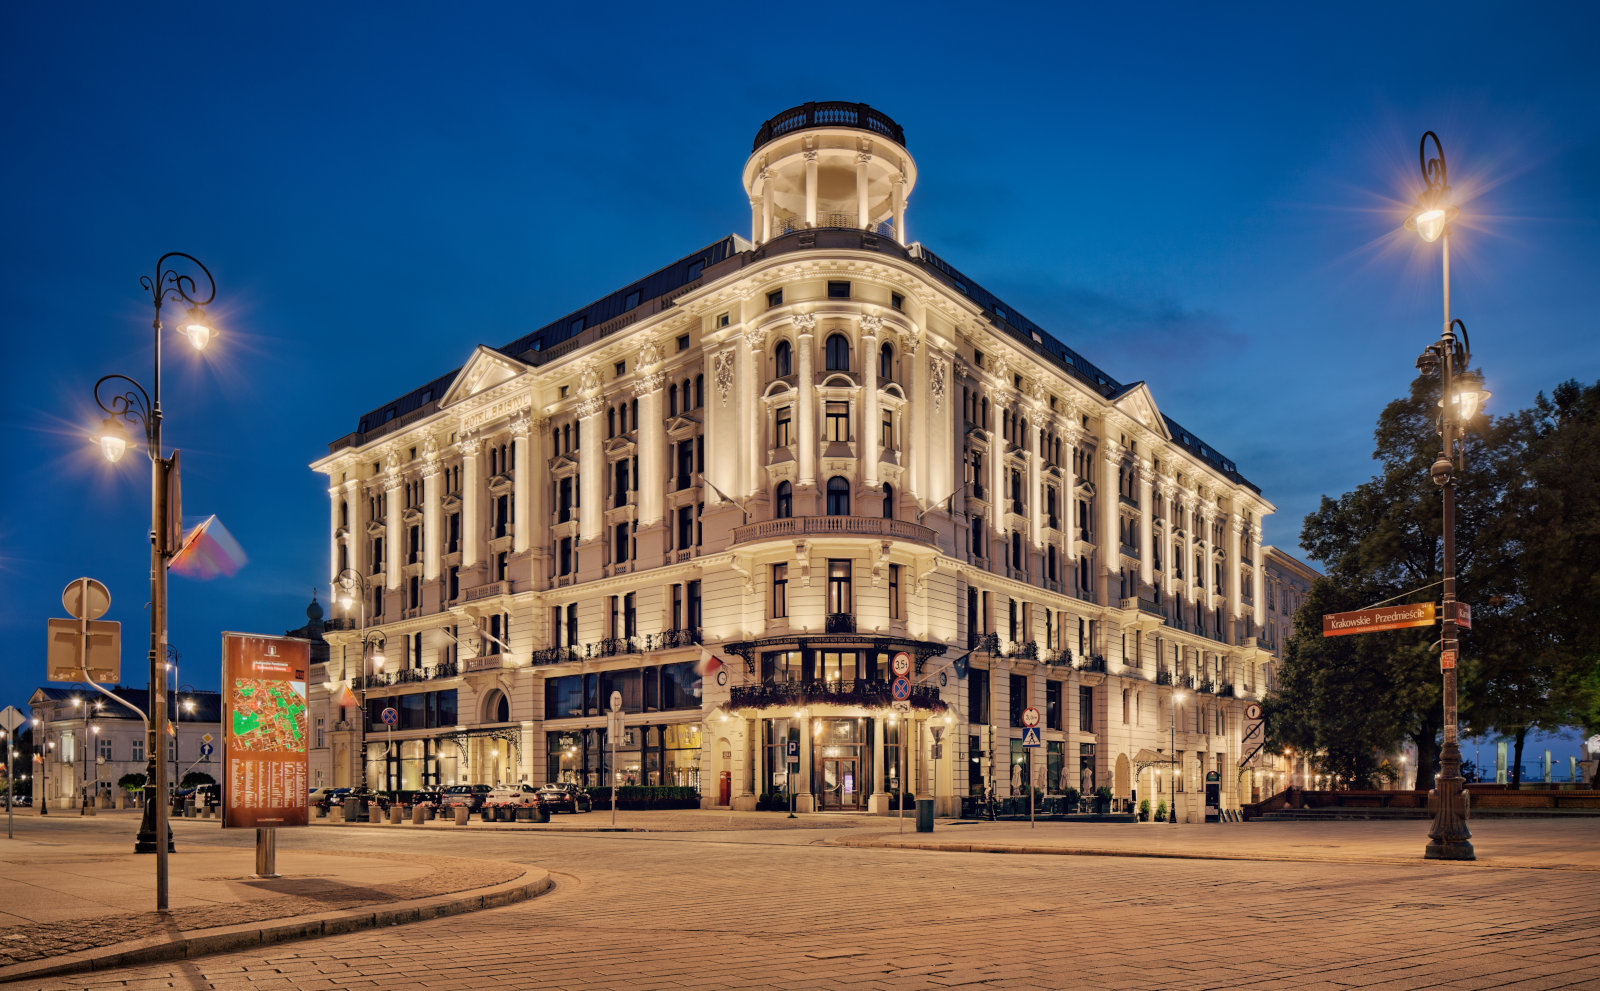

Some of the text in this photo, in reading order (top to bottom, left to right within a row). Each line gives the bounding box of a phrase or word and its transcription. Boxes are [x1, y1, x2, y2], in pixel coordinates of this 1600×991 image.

[464, 394, 529, 430] HOTEL BRISTOL
[1331, 615, 1371, 630] Krakowskie
[1375, 608, 1425, 624] Przedmieście
[789, 742, 796, 755] P
